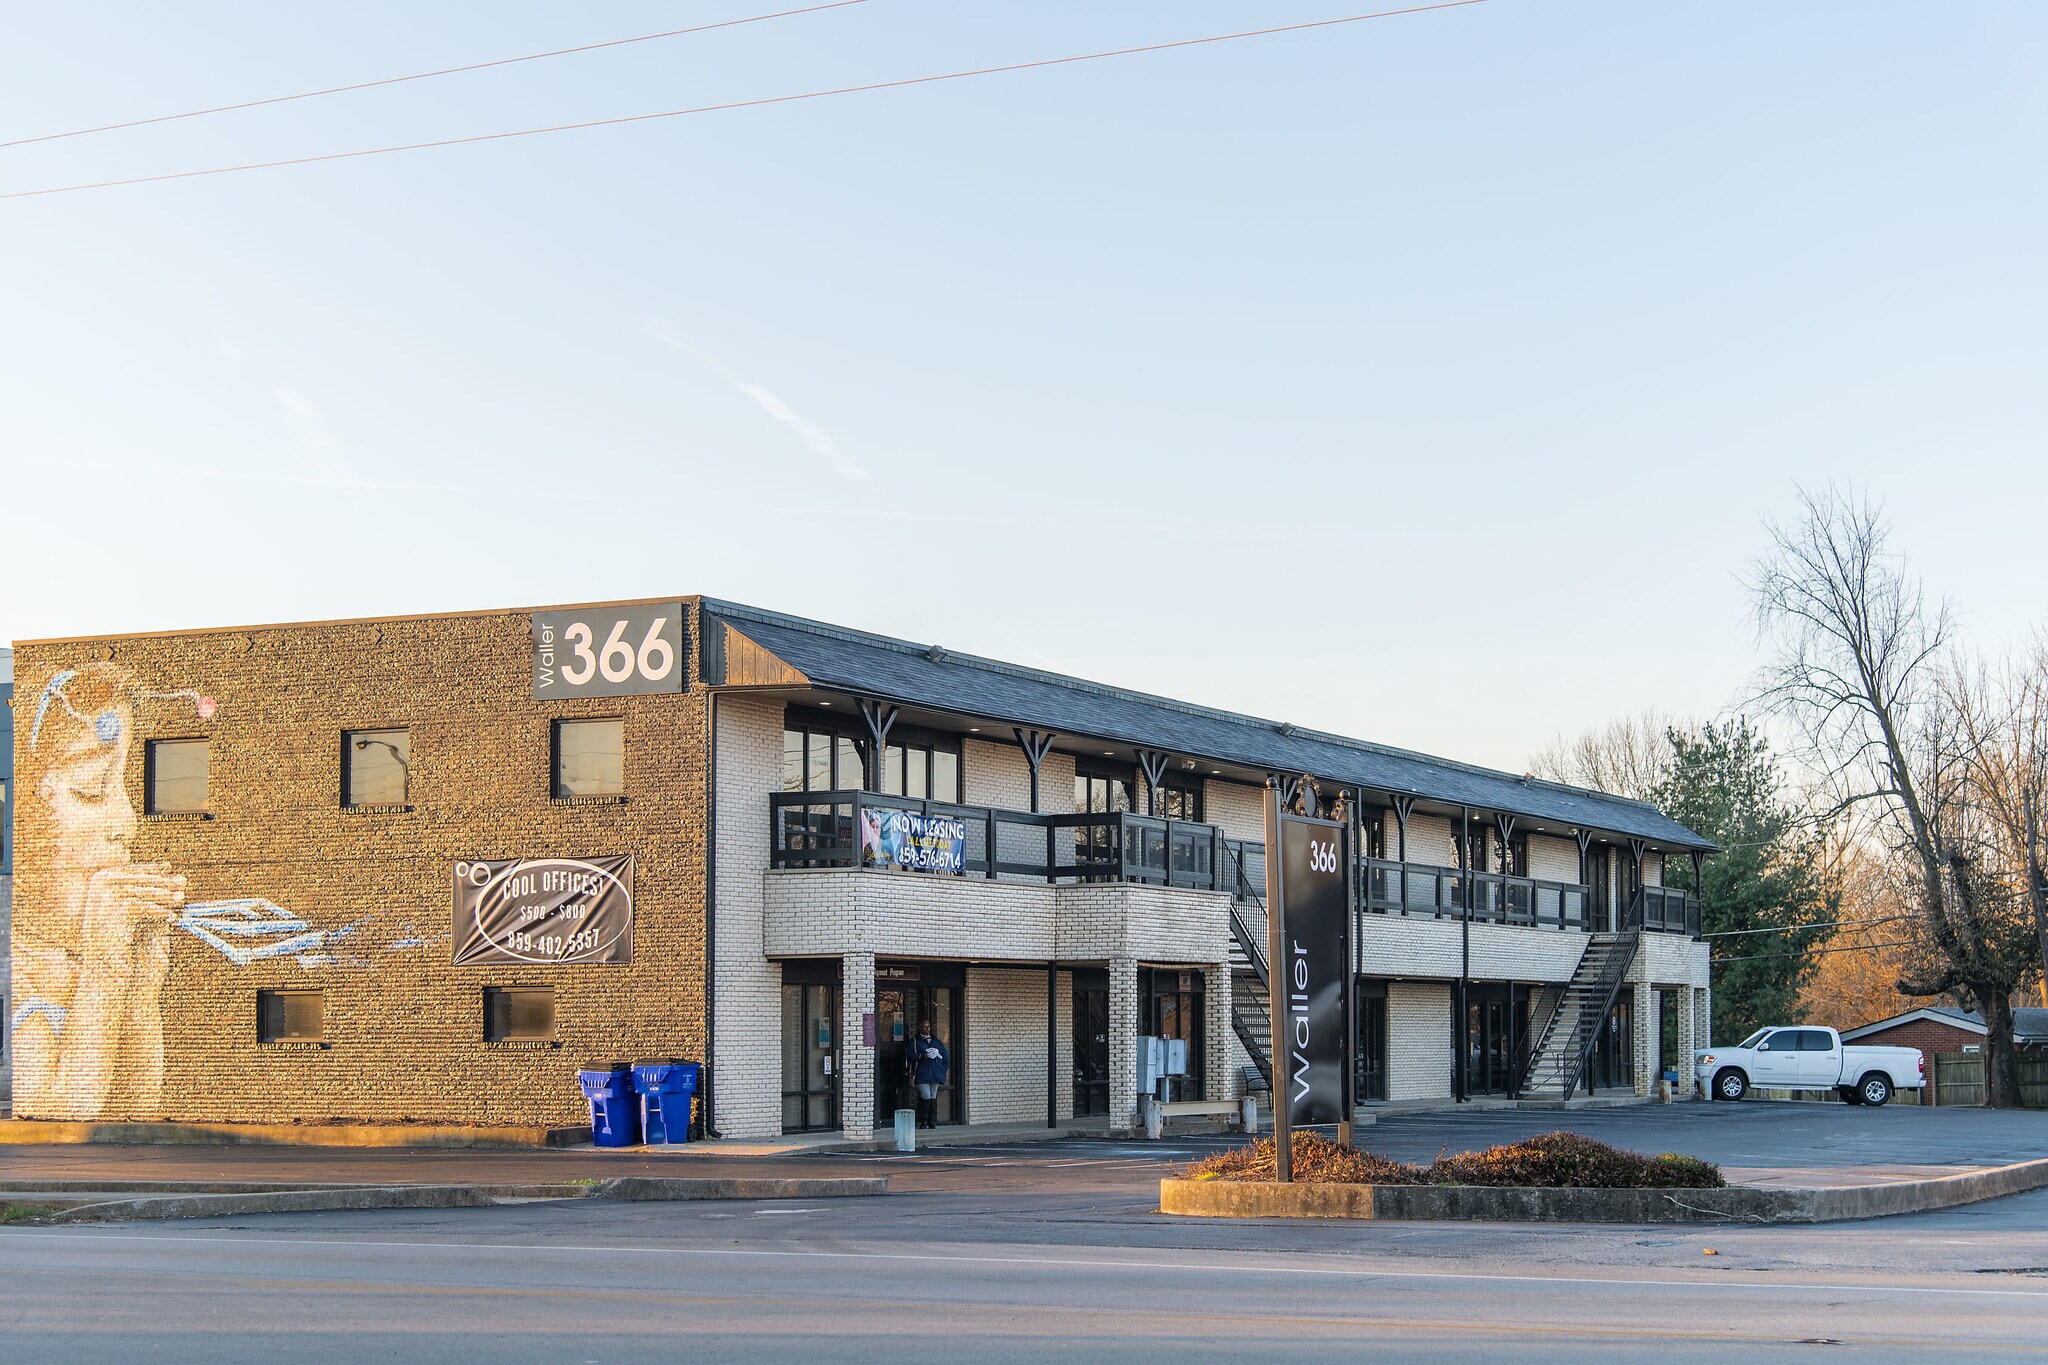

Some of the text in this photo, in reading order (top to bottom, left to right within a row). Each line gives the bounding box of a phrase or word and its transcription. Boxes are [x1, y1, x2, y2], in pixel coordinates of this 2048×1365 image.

[539, 623, 554, 688] Waller
[561, 617, 674, 685] 366
[892, 815, 964, 840] NOW LEASING
[906, 836, 923, 847] CALL
[899, 847, 961, 869] 859-576-6714
[1310, 840, 1337, 874] 366
[503, 870, 603, 901] COOL OFFICES!
[520, 905, 546, 922] $500
[559, 904, 586, 922] $800
[507, 928, 600, 955] 859-402-5357
[1292, 940, 1310, 1103] Waller
